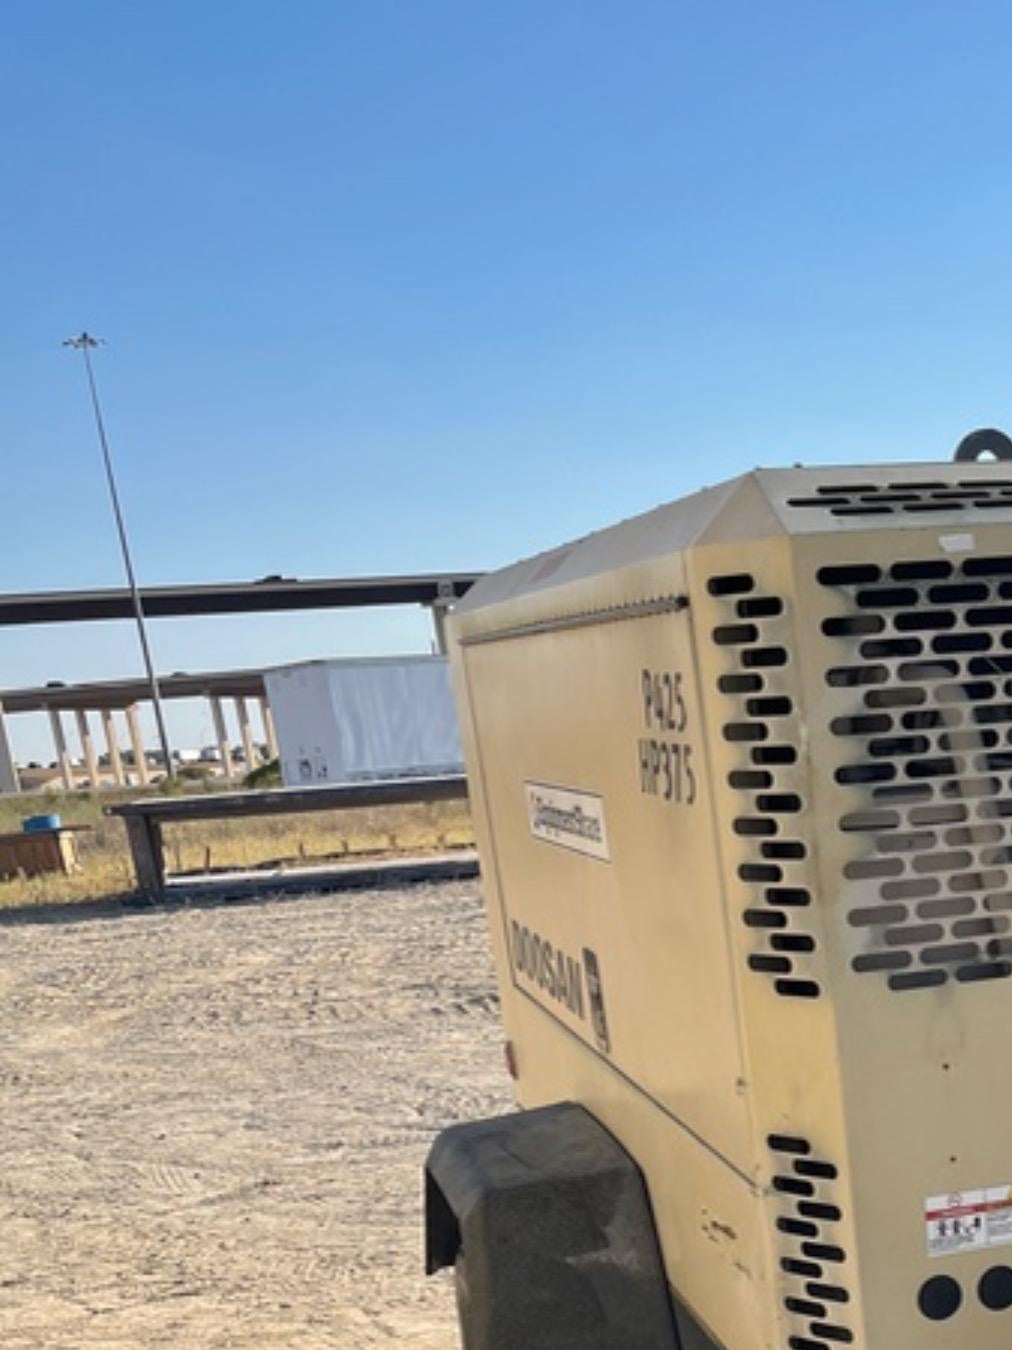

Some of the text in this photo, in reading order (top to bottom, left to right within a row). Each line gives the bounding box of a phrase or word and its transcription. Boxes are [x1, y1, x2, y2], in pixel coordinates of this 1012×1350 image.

[641, 668, 689, 733] P425
[637, 737, 697, 805] HP375
[511, 919, 585, 1021] DOOSAN
